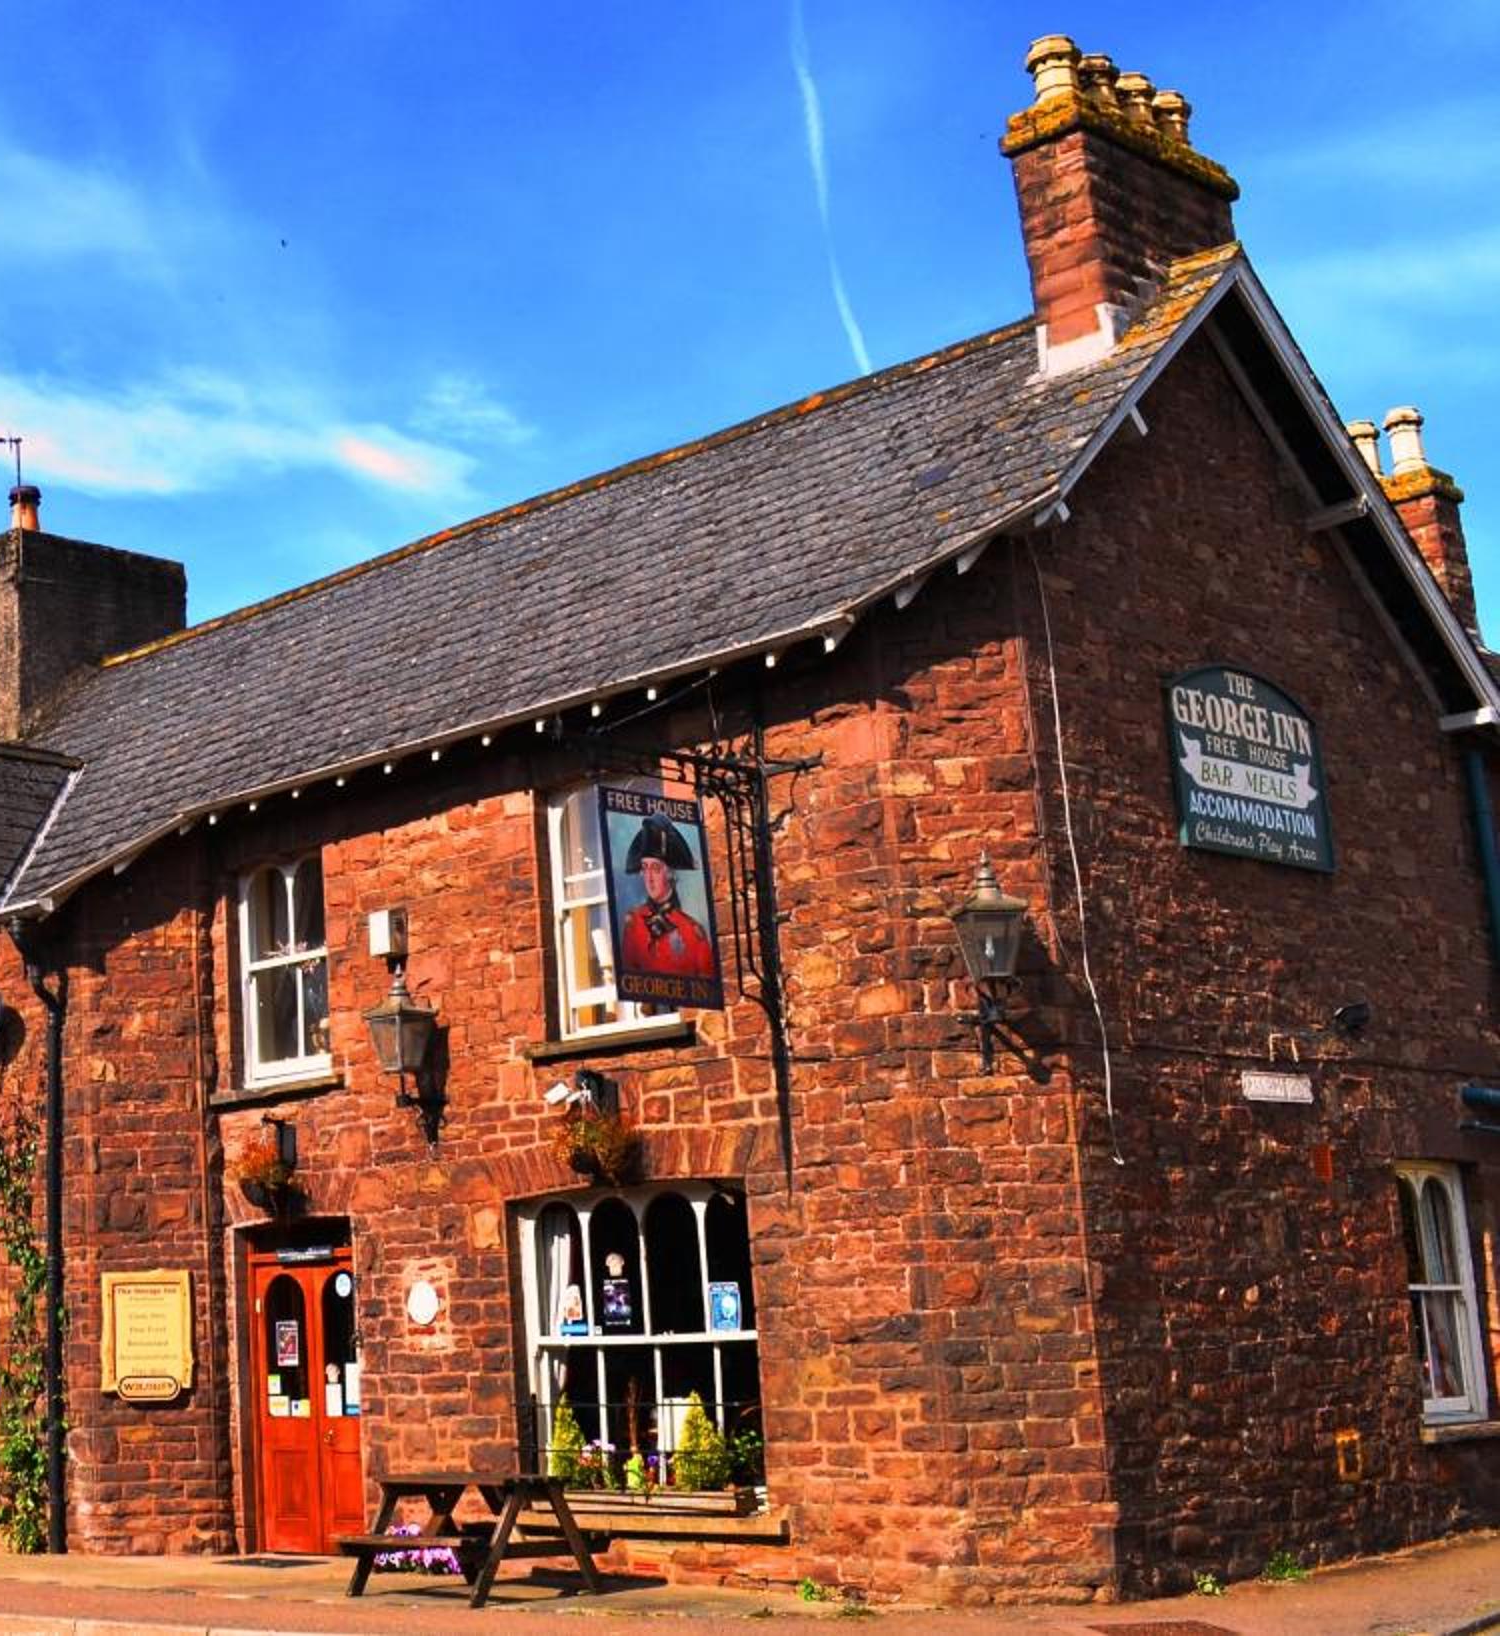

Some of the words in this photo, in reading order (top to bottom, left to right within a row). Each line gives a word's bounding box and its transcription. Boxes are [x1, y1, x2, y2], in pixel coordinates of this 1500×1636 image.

[1223, 672, 1255, 700] THE
[1172, 686, 1271, 746] GEORGE
[1271, 711, 1312, 757] INN
[1205, 733, 1239, 758] FREE
[1249, 748, 1289, 771] HOUSE
[1201, 760, 1233, 787] BAR
[1245, 769, 1297, 800] MEALS
[607, 790, 642, 812] FREE
[647, 796, 694, 821] HOUSE
[1189, 791, 1317, 838] ACCOMMODATION
[1258, 832, 1284, 859] Play
[1287, 841, 1318, 861] Area
[620, 974, 686, 998] GEORGE
